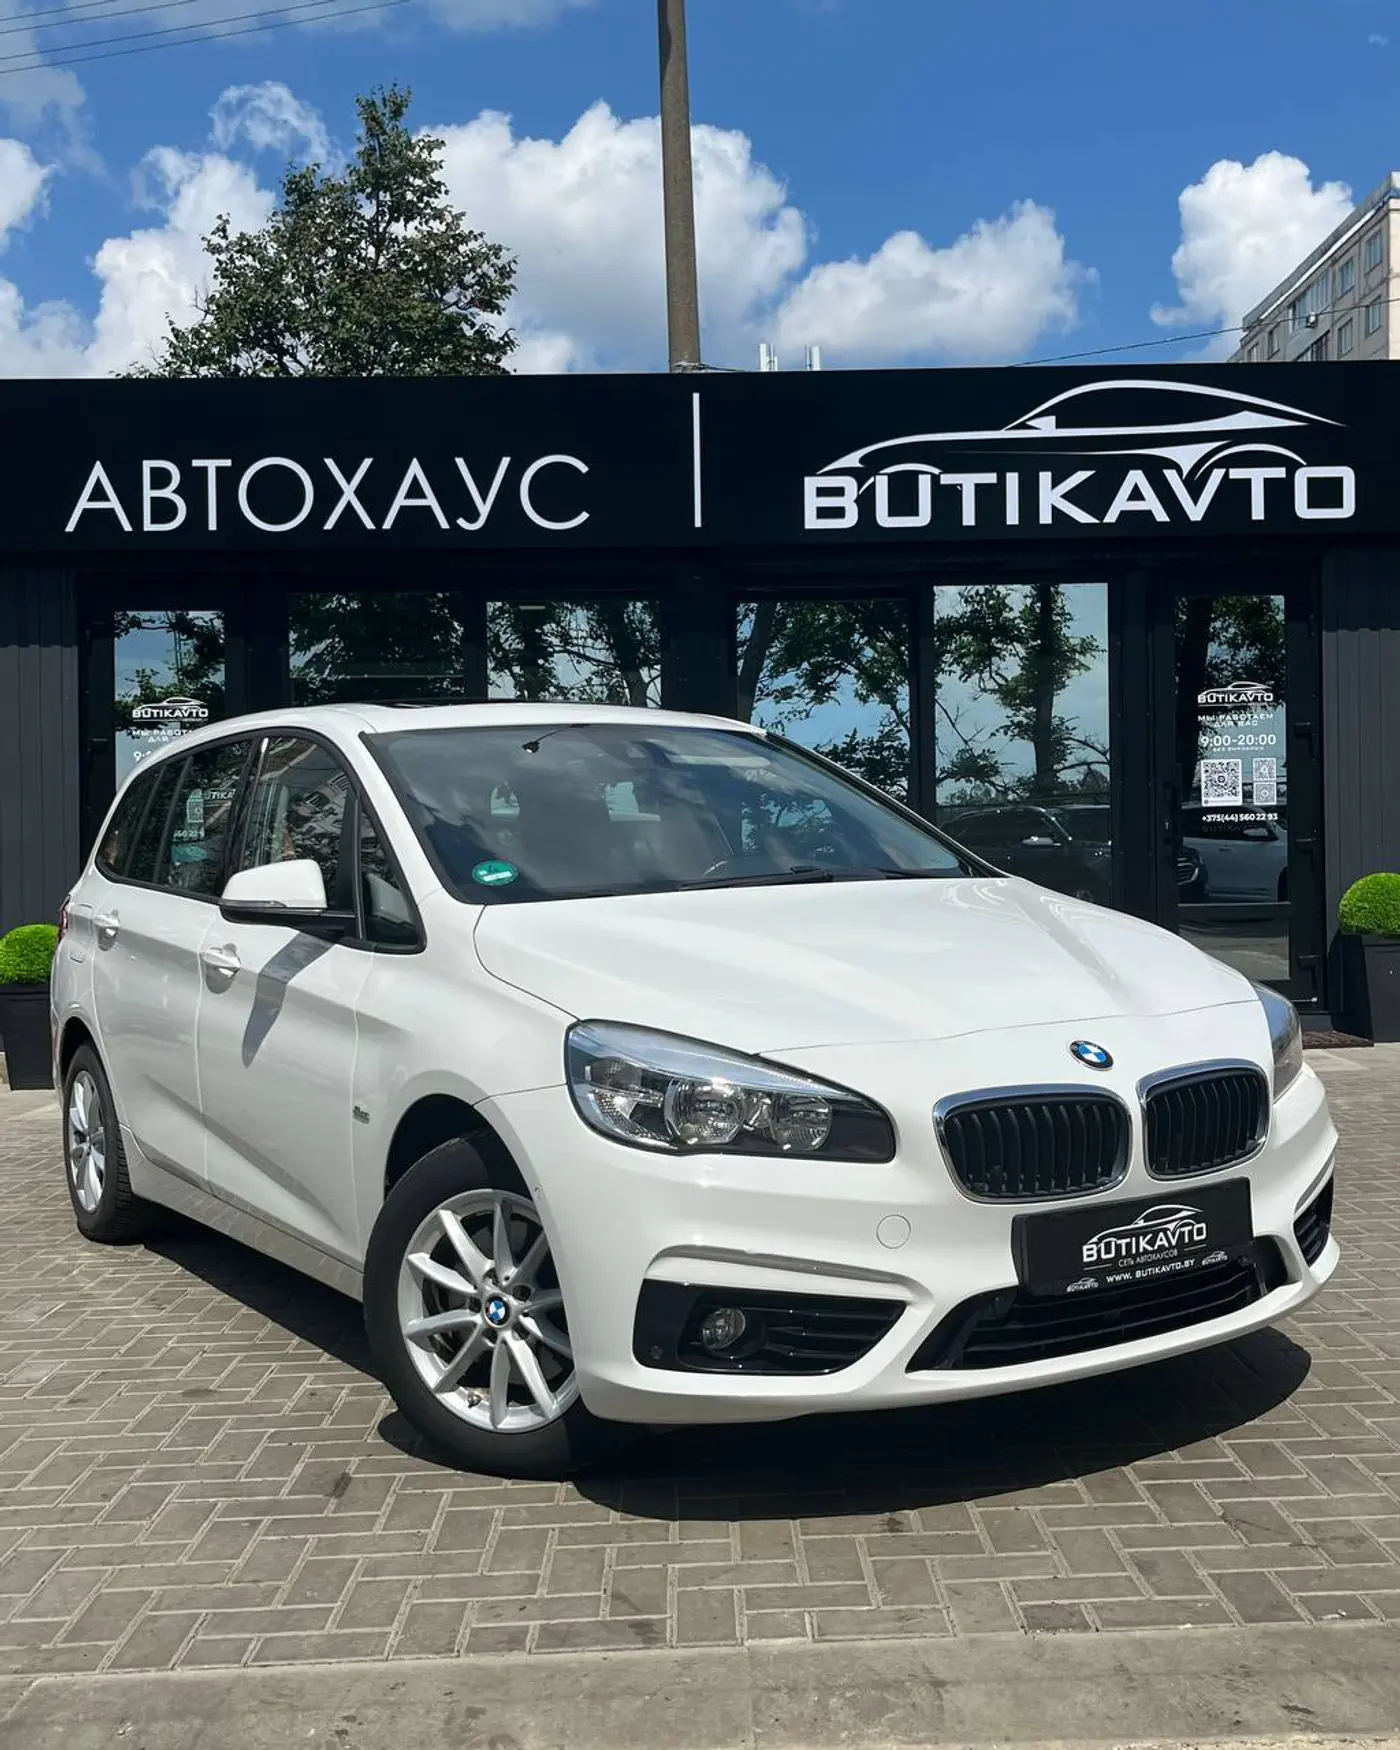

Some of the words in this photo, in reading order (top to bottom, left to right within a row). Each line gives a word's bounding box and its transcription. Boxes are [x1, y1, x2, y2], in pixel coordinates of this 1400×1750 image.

[64, 453, 591, 533] АВТОХАУС
[803, 465, 1356, 529] BUTIKAVTO
[1197, 692, 1274, 704] BUTIKAVTO
[132, 708, 209, 718] BUTIKAVTO
[1200, 733, 1277, 748] 9:00-20:00
[1201, 813, 1239, 823] +375(44)
[1082, 1222, 1207, 1263] BUTIKAVTO
[1118, 1257, 1135, 1268] СЕТЬ
[1105, 1271, 1133, 1284] WWW.
[1135, 1258, 1196, 1279] BUTIKAVTO.BY
